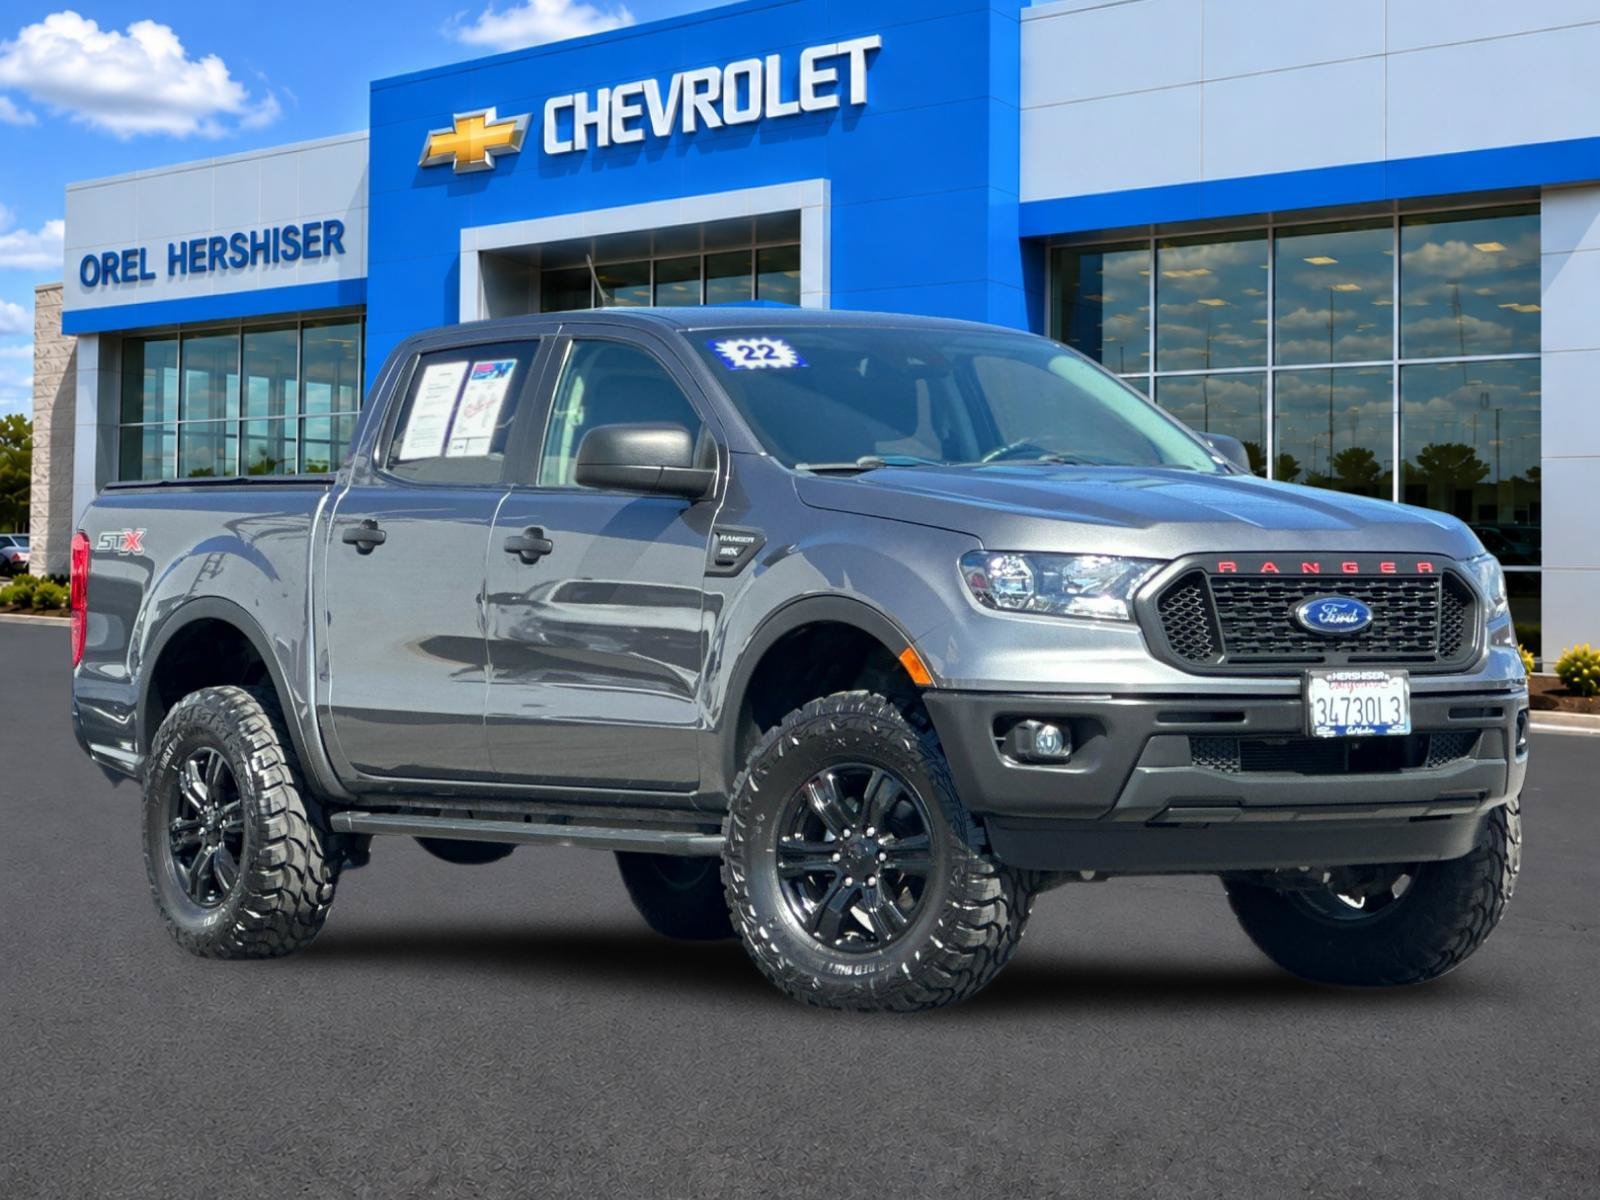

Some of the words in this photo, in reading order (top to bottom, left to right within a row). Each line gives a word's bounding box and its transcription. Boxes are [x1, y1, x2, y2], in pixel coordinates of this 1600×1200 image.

[544, 34, 882, 155] CHEVROLET
[79, 247, 156, 288] OREL
[167, 219, 346, 277] HERSHISER
[737, 344, 782, 361] 22
[96, 528, 147, 556] STX
[720, 534, 755, 542] RANGER
[1218, 562, 1433, 573] RANGER
[1319, 603, 1358, 623] Ford
[1316, 696, 1401, 726] 34730L3
